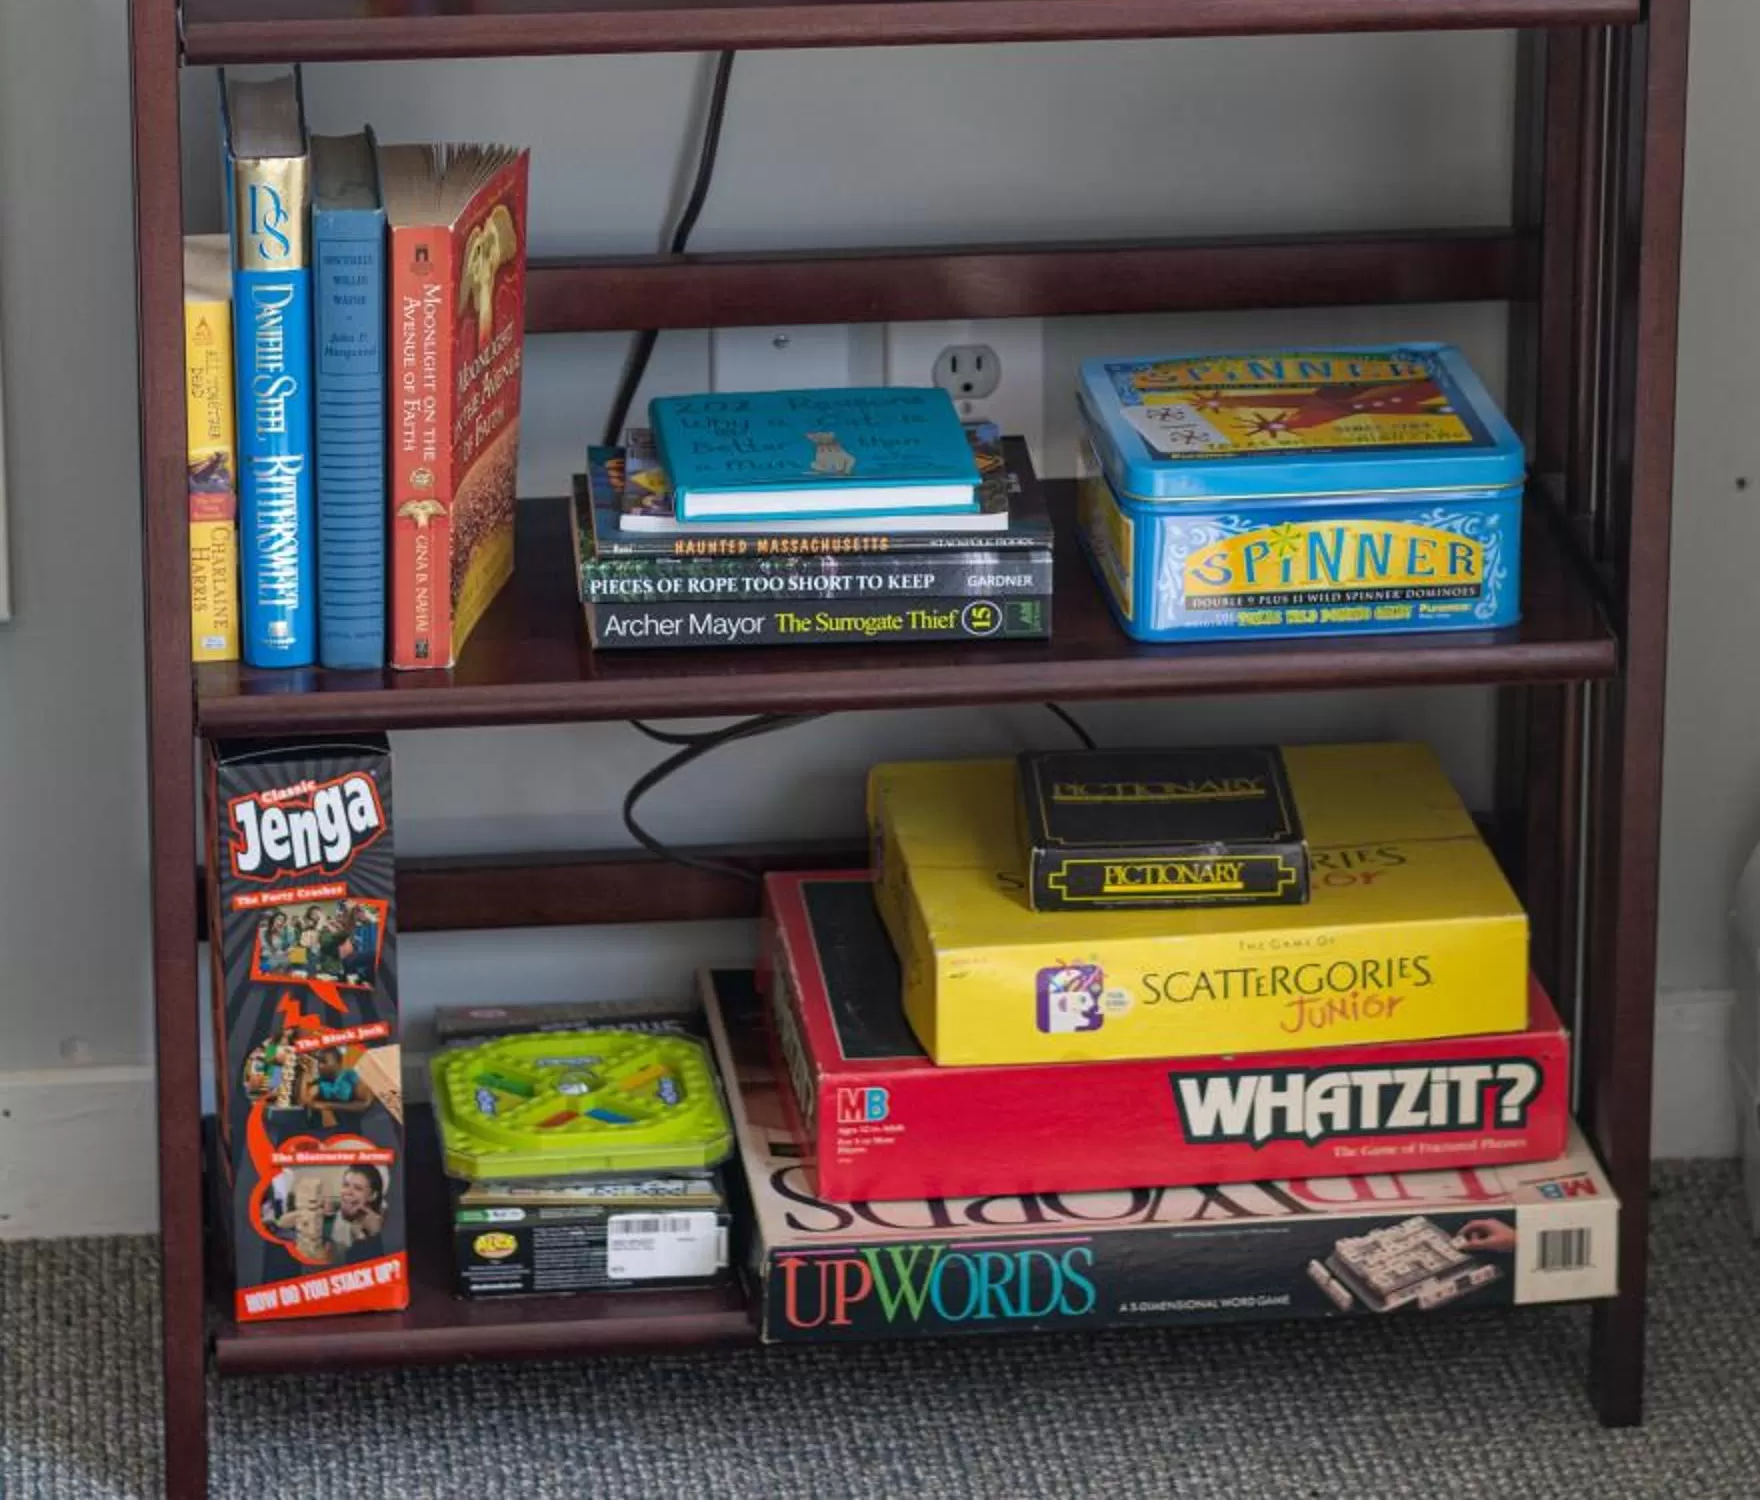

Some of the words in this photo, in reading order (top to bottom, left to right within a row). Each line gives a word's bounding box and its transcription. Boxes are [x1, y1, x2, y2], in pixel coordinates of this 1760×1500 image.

[402, 295, 421, 367] AVENUE
[423, 283, 443, 393] MOONLIGHT
[402, 372, 416, 393] OF
[402, 399, 421, 452] FAITH
[423, 396, 437, 423] ON
[423, 428, 437, 461] THE
[254, 453, 305, 610] BITTERSWEET
[674, 538, 748, 557] HAUNTED
[756, 535, 891, 556] MASSACHUSETTS
[590, 577, 653, 596] PIECES
[656, 577, 683, 594] OF
[688, 576, 739, 594] ROPE
[741, 575, 784, 592] TOO
[787, 574, 854, 592] SHORT
[855, 574, 883, 591] TO
[887, 573, 936, 590] KEEP
[967, 574, 1034, 588] GARDNER
[604, 612, 683, 638] Archer
[688, 612, 766, 641] Mayor
[773, 612, 812, 635] The
[815, 610, 903, 636] Surrogate
[904, 608, 961, 631] Thief
[260, 778, 317, 803] Classic
[235, 775, 380, 872] Jenga
[1103, 861, 1246, 886] PICTIONARY
[1141, 955, 1434, 1006] SCATTERGORIES
[836, 1086, 891, 1124] MB
[1333, 1146, 1356, 1157] The
[1359, 1145, 1397, 1157] Game
[1401, 1142, 1416, 1155] of
[244, 1289, 278, 1314] HOW
[279, 1283, 300, 1307] DO
[301, 1277, 330, 1303] YOU
[773, 1243, 1098, 1330] UPWORDS
